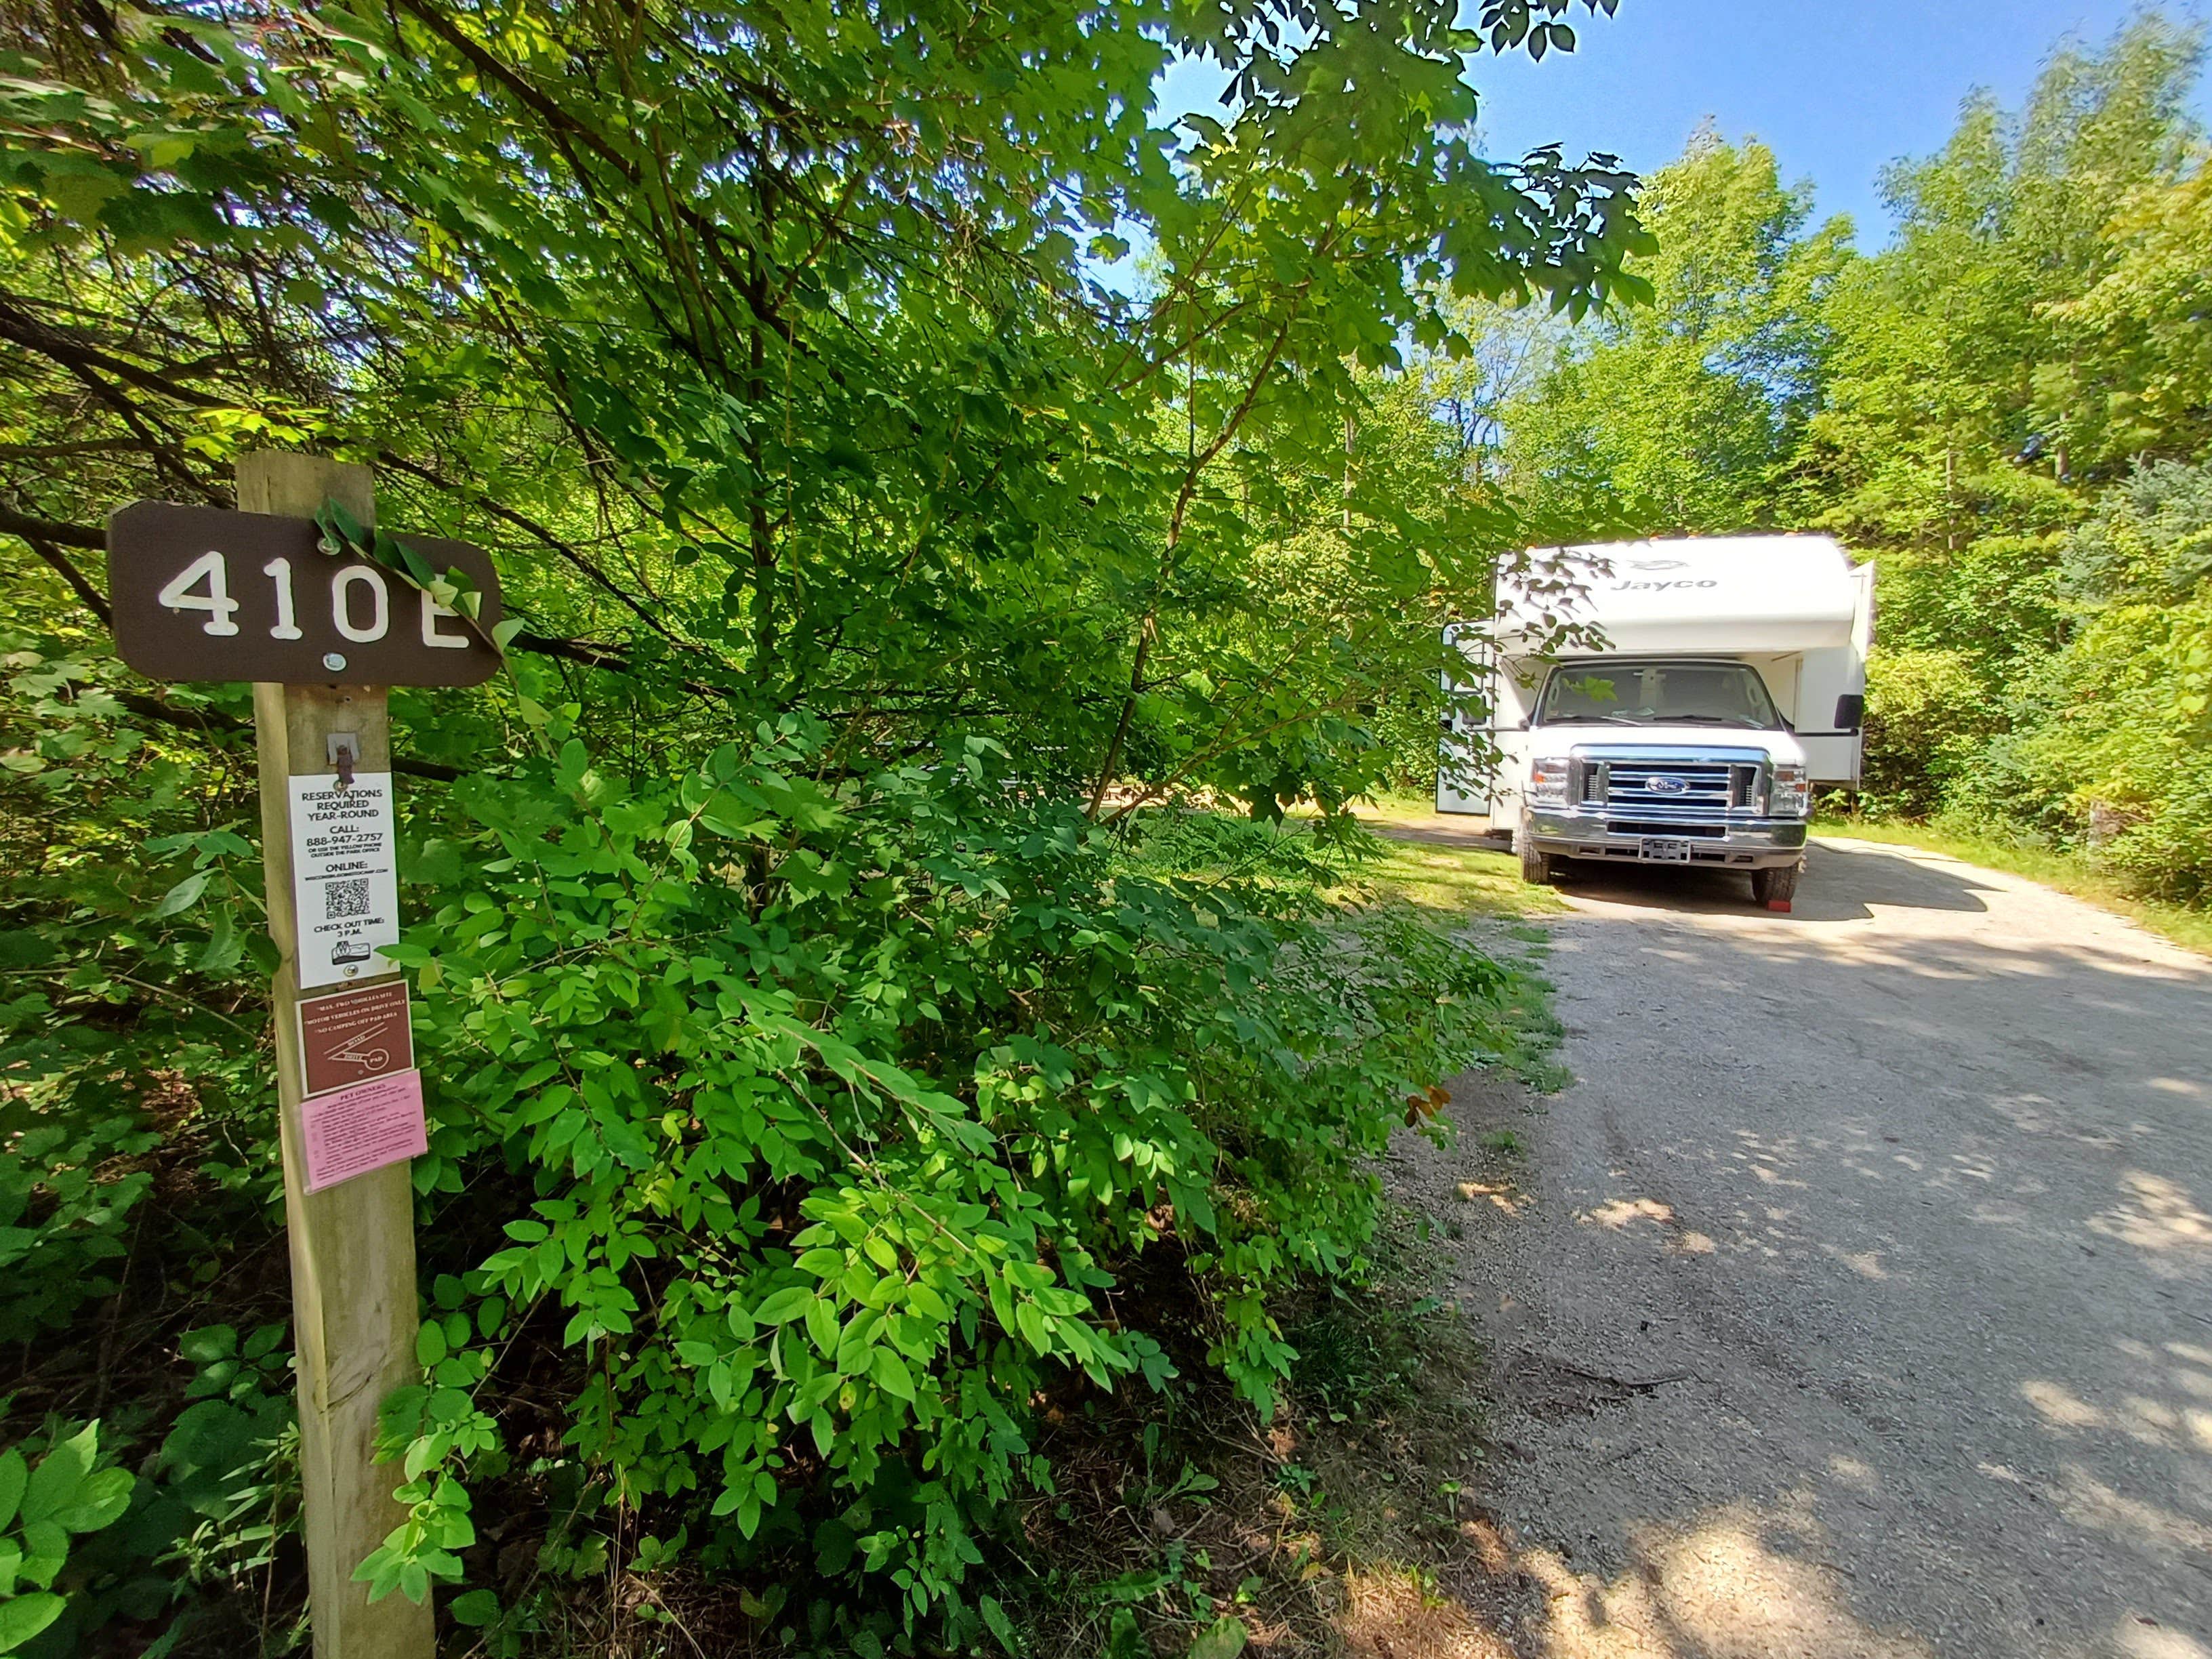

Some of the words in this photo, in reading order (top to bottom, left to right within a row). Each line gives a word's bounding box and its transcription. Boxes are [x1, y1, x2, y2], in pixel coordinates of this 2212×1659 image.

[1610, 580, 1718, 592] Jayco
[302, 790, 383, 801] RESERVATIONS
[317, 800, 369, 811] REQUIRED
[308, 809, 379, 821] YEAR-ROUND
[329, 825, 360, 834] CALL:
[307, 833, 383, 846] 888-947-2757
[325, 861, 368, 872] ONLINE:
[314, 924, 342, 933] CHECK
[344, 921, 361, 929] OUT
[364, 917, 384, 926] TIME:
[331, 1010, 360, 1019] VEHICLES
[371, 1003, 388, 1011] DRIVE
[328, 1021, 356, 1031] CAMPING
[340, 1092, 354, 1101] PET
